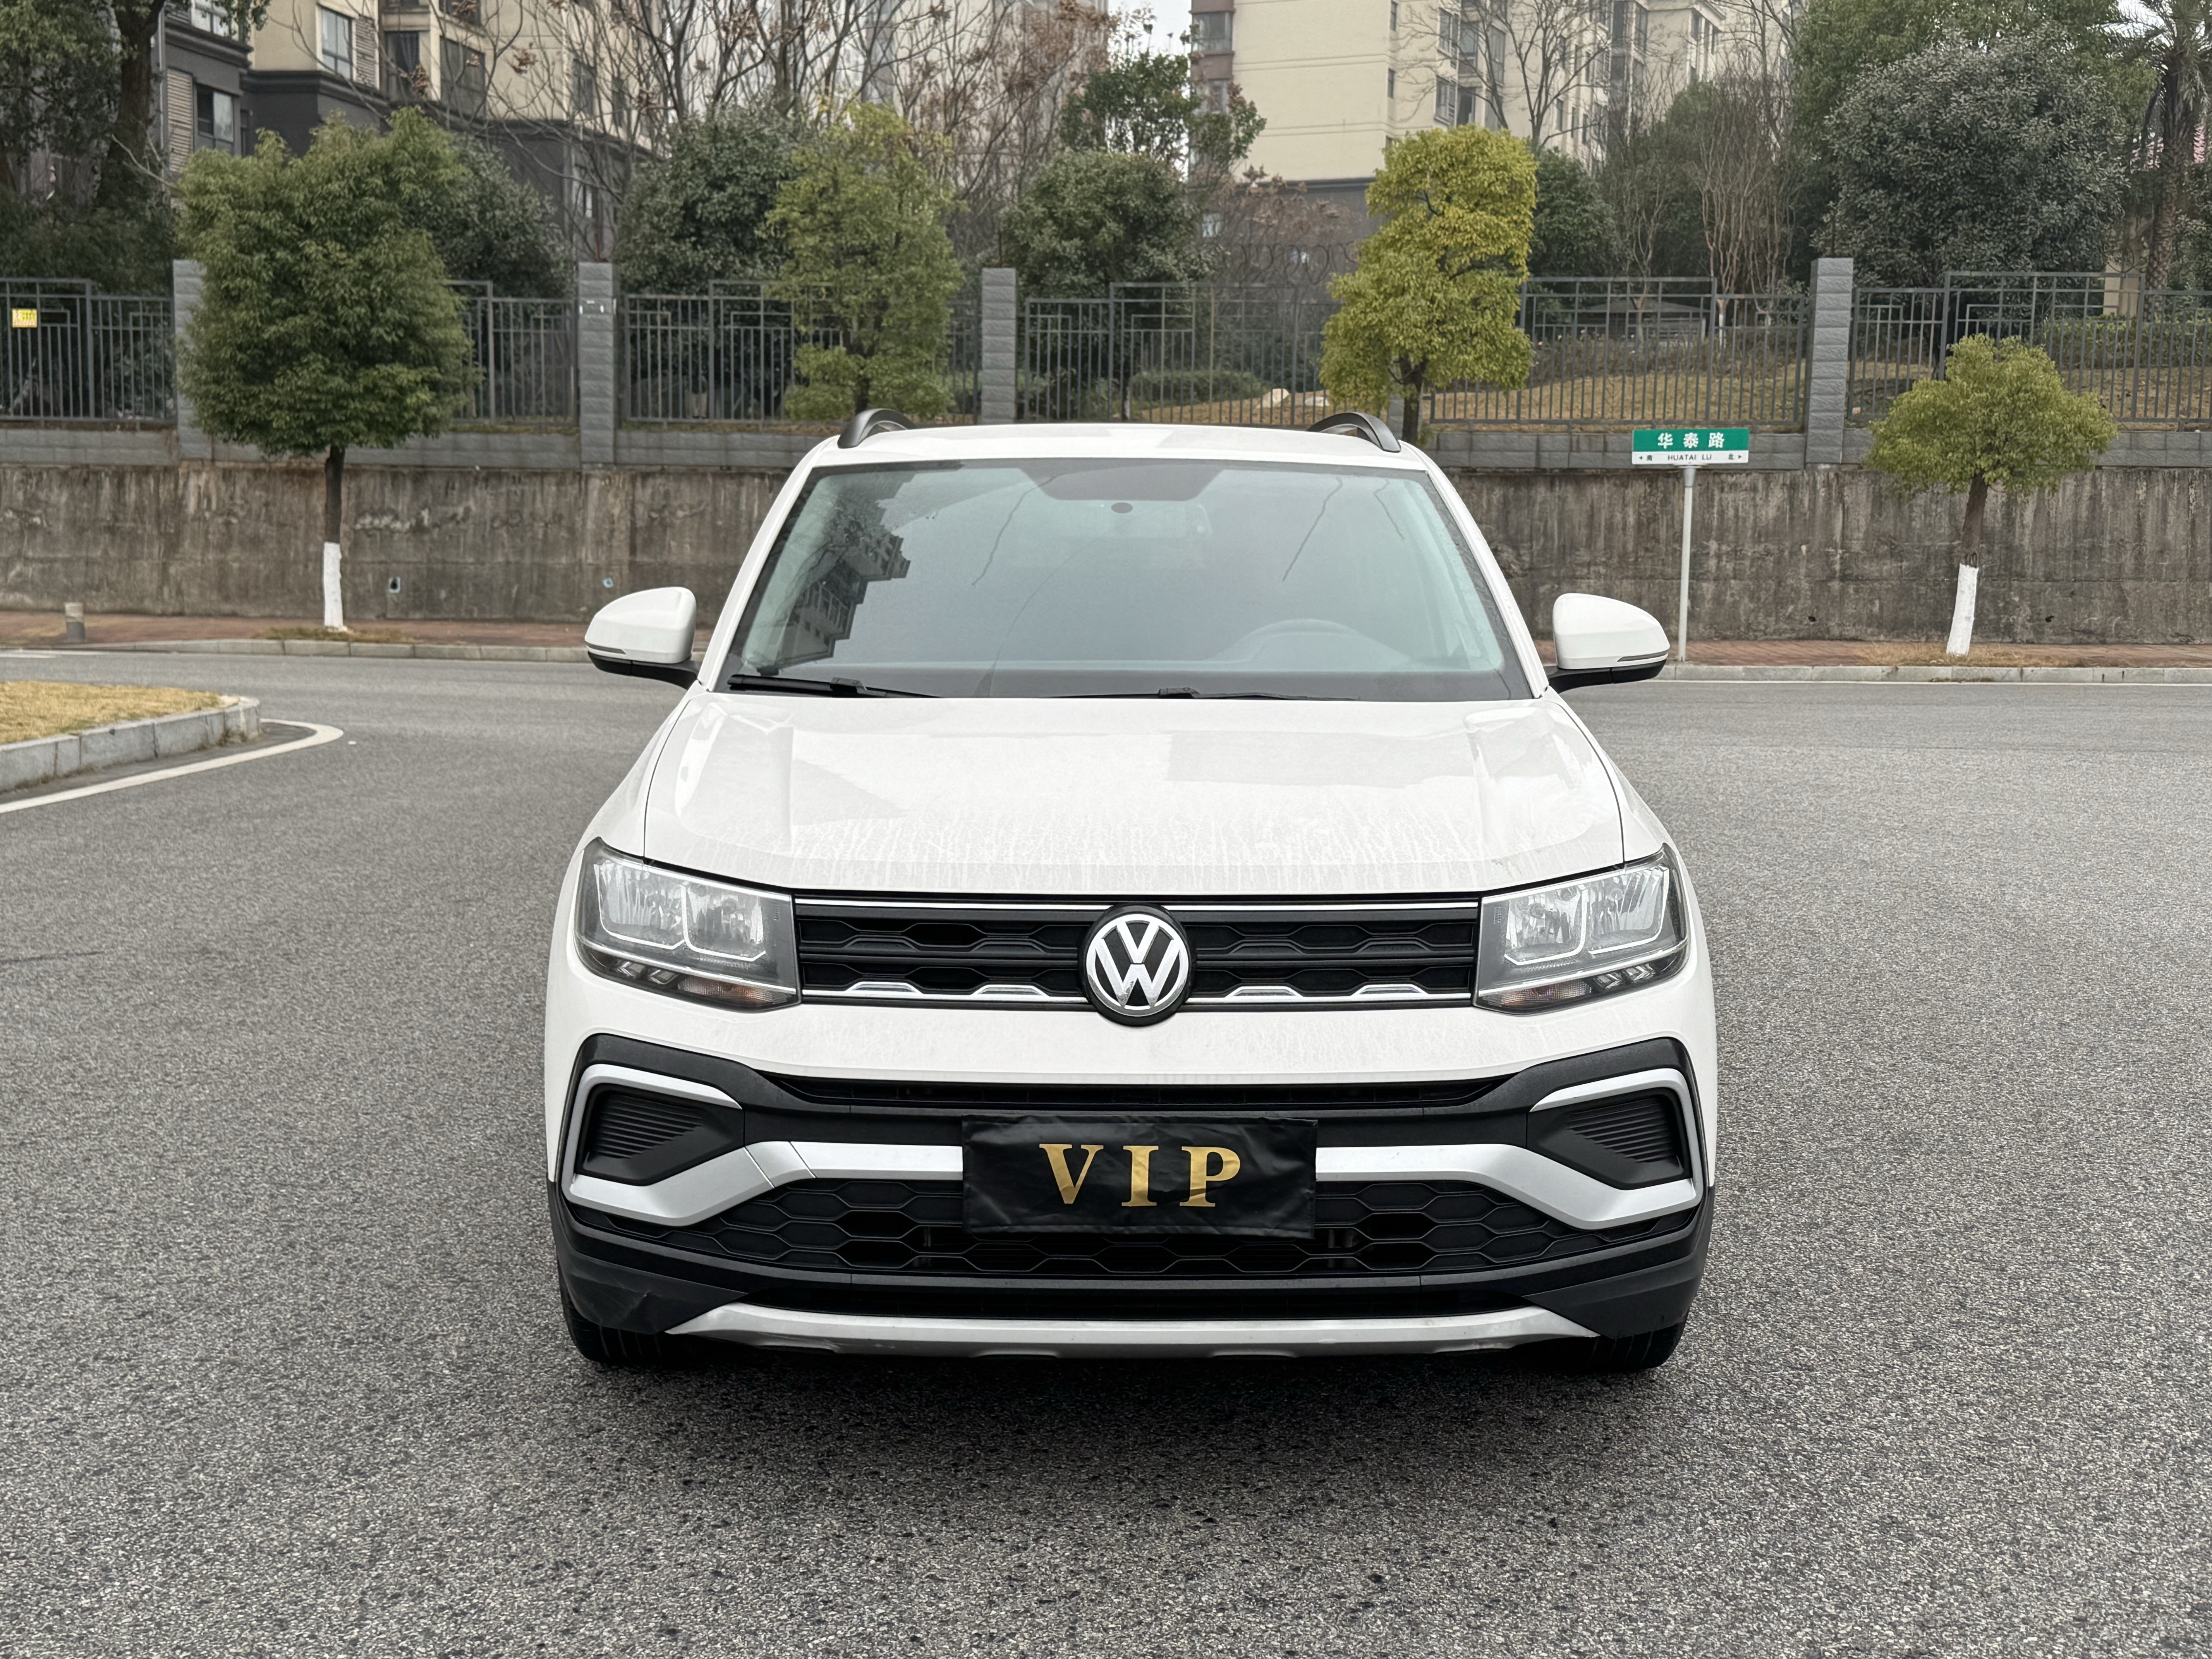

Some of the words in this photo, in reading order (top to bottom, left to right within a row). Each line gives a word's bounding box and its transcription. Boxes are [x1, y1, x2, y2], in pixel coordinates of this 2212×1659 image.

[1657, 432, 1724, 449] 华泰路
[1086, 914, 1189, 1017] VW
[1039, 1144, 1240, 1207] VIP
